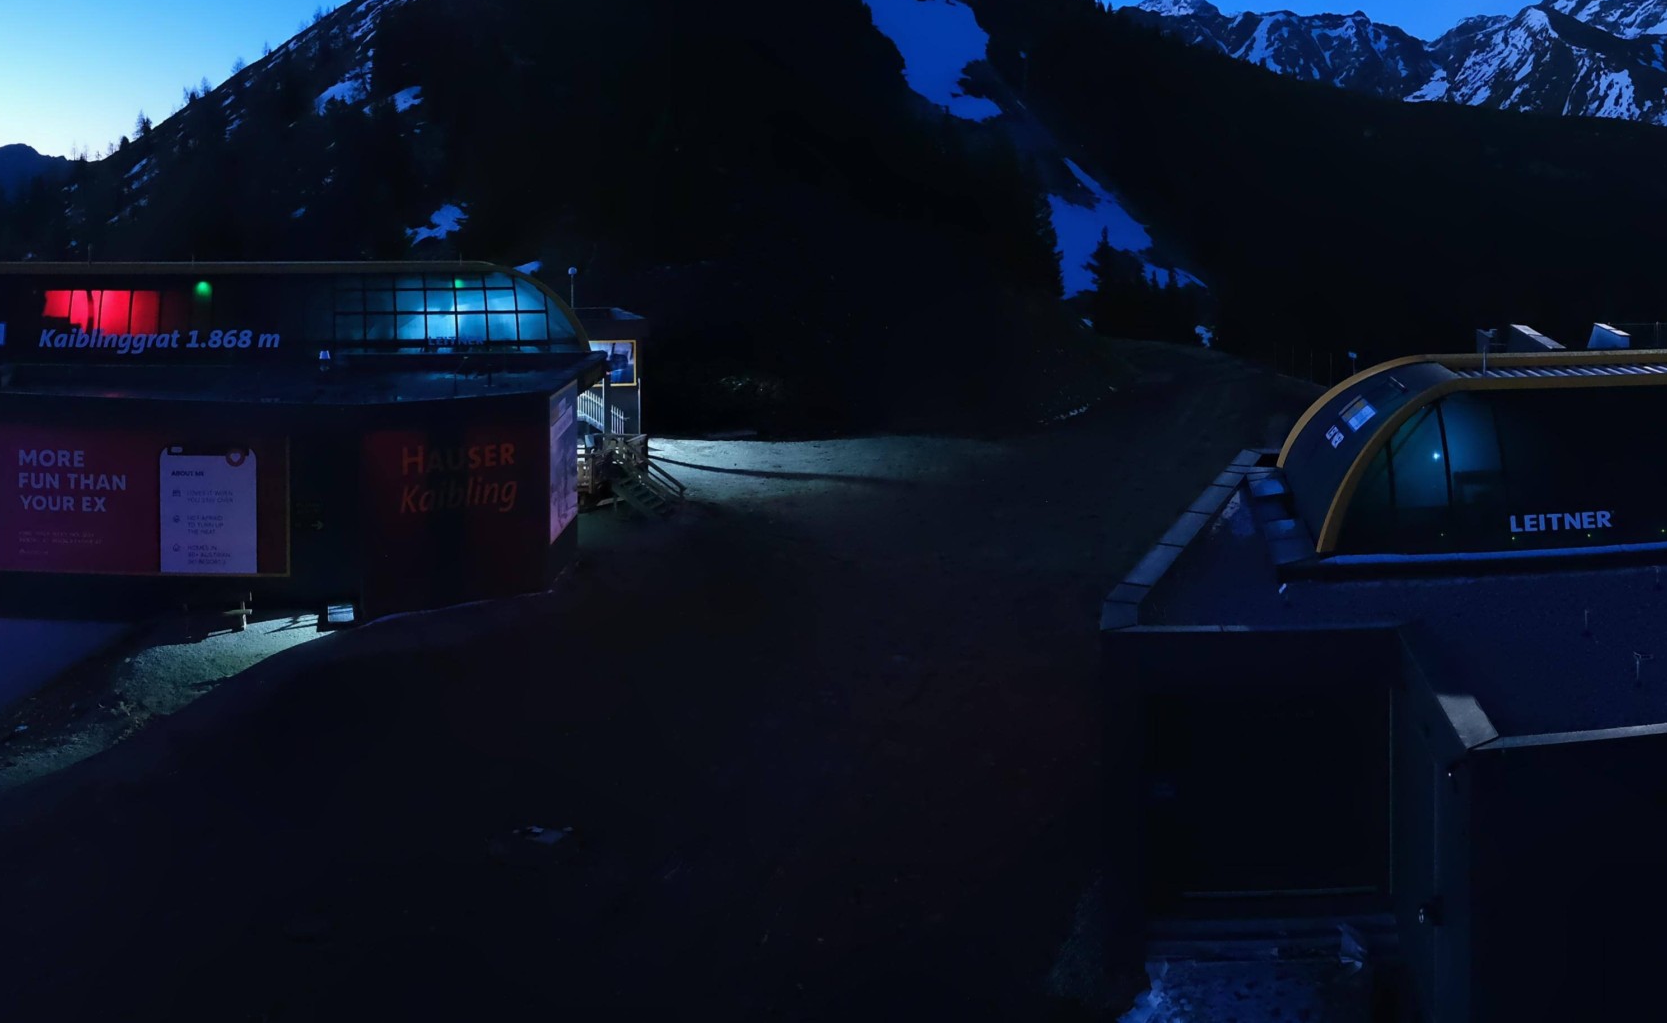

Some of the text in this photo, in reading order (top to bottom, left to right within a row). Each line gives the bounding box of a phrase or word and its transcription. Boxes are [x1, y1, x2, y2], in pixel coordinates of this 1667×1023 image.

[39, 329, 281, 355] Kaiblinggrat 1.868 m
[427, 336, 484, 346] LEITNER
[18, 449, 85, 468] MORE
[401, 442, 516, 475] HAUSER
[18, 472, 127, 491] FUN THAN
[20, 495, 107, 513] YOUR EX
[400, 476, 518, 514] Kaibling
[1509, 510, 1613, 533] LEITNER
